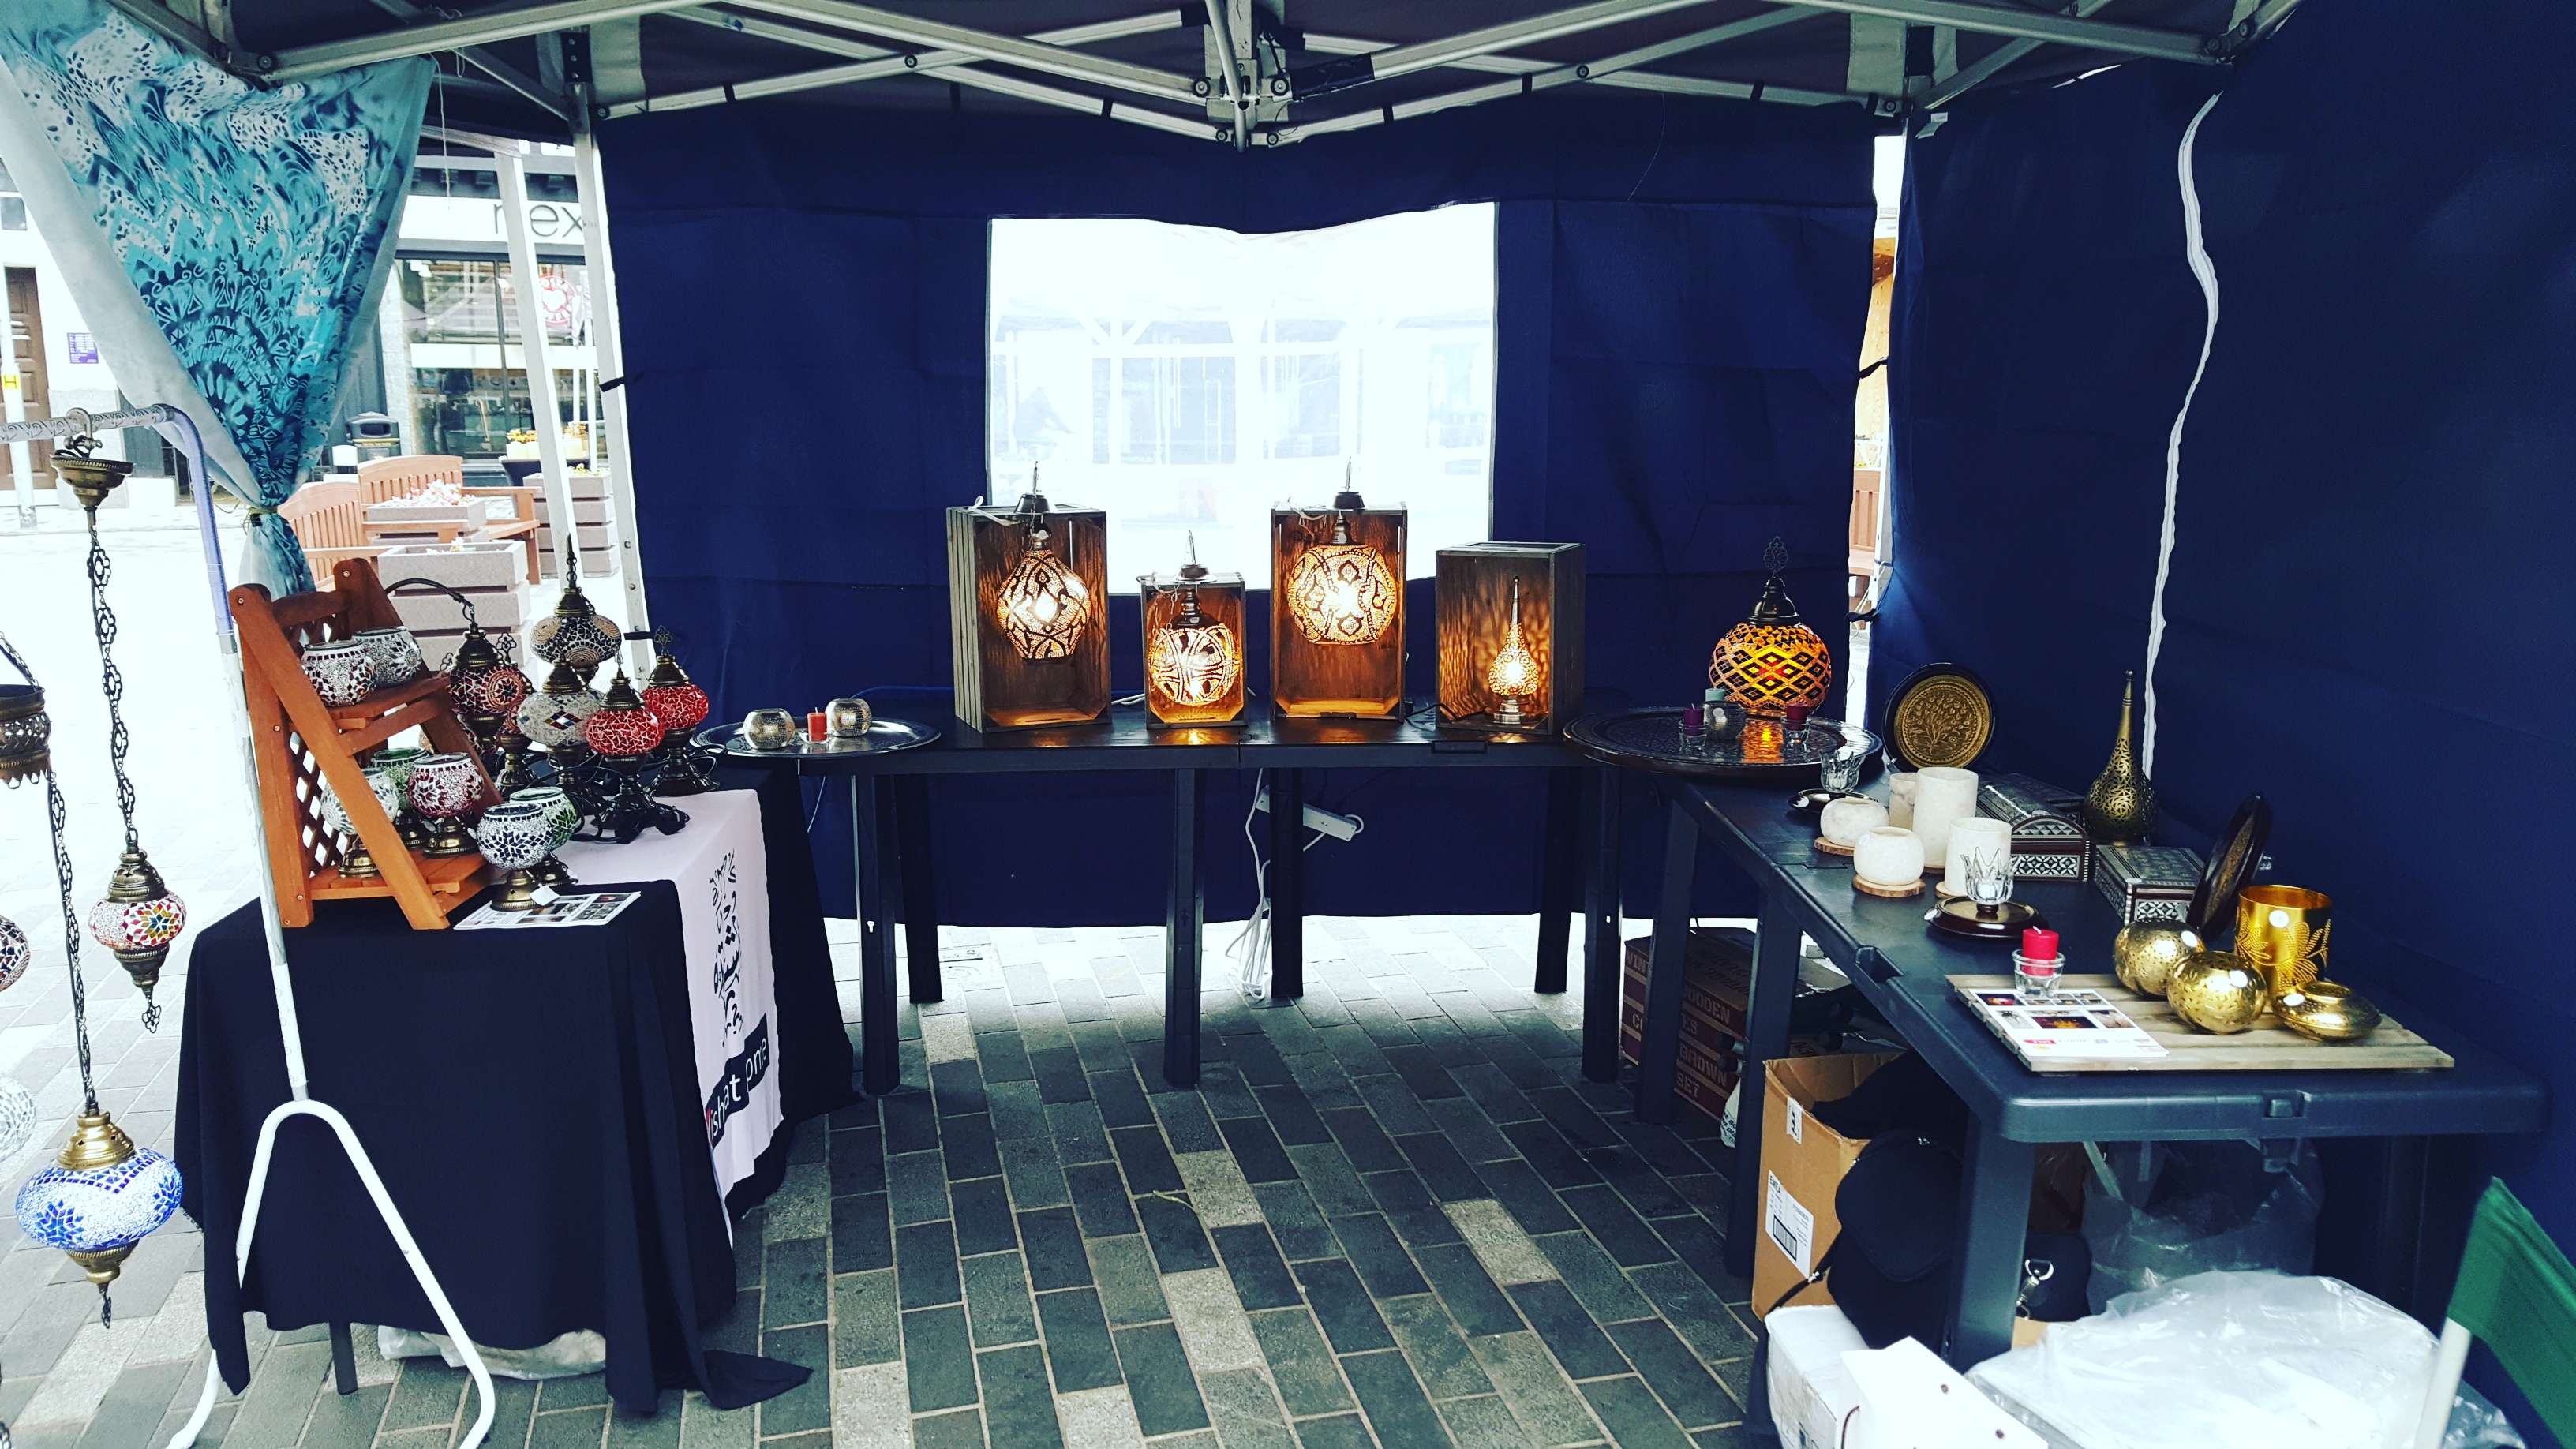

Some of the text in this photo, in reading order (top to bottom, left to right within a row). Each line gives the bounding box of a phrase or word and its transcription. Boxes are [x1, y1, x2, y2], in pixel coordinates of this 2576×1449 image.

[4, 375, 17, 389] H
[1684, 985, 1730, 1024] OODEN
[1679, 1042, 1727, 1088] BROWN
[1676, 1071, 1700, 1099] SET
